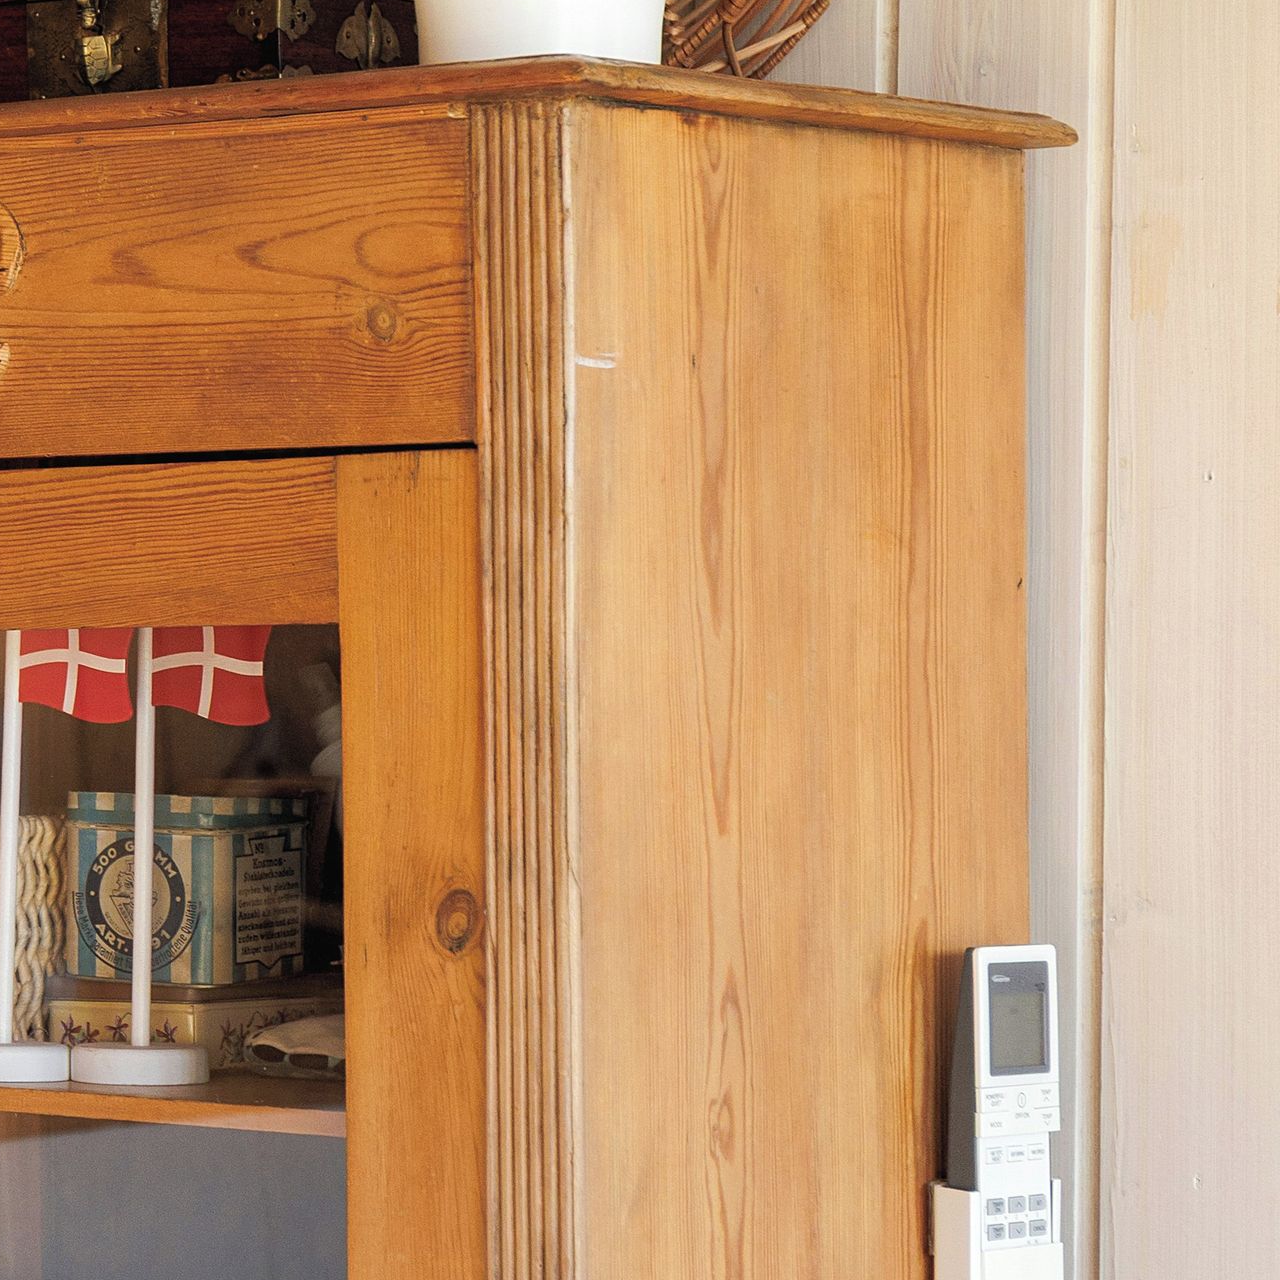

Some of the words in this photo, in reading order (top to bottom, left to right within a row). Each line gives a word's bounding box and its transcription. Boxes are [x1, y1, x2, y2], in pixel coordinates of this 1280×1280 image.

[92, 847, 117, 875] 500
[125, 840, 177, 878] GMM
[94, 923, 128, 952] ART.
